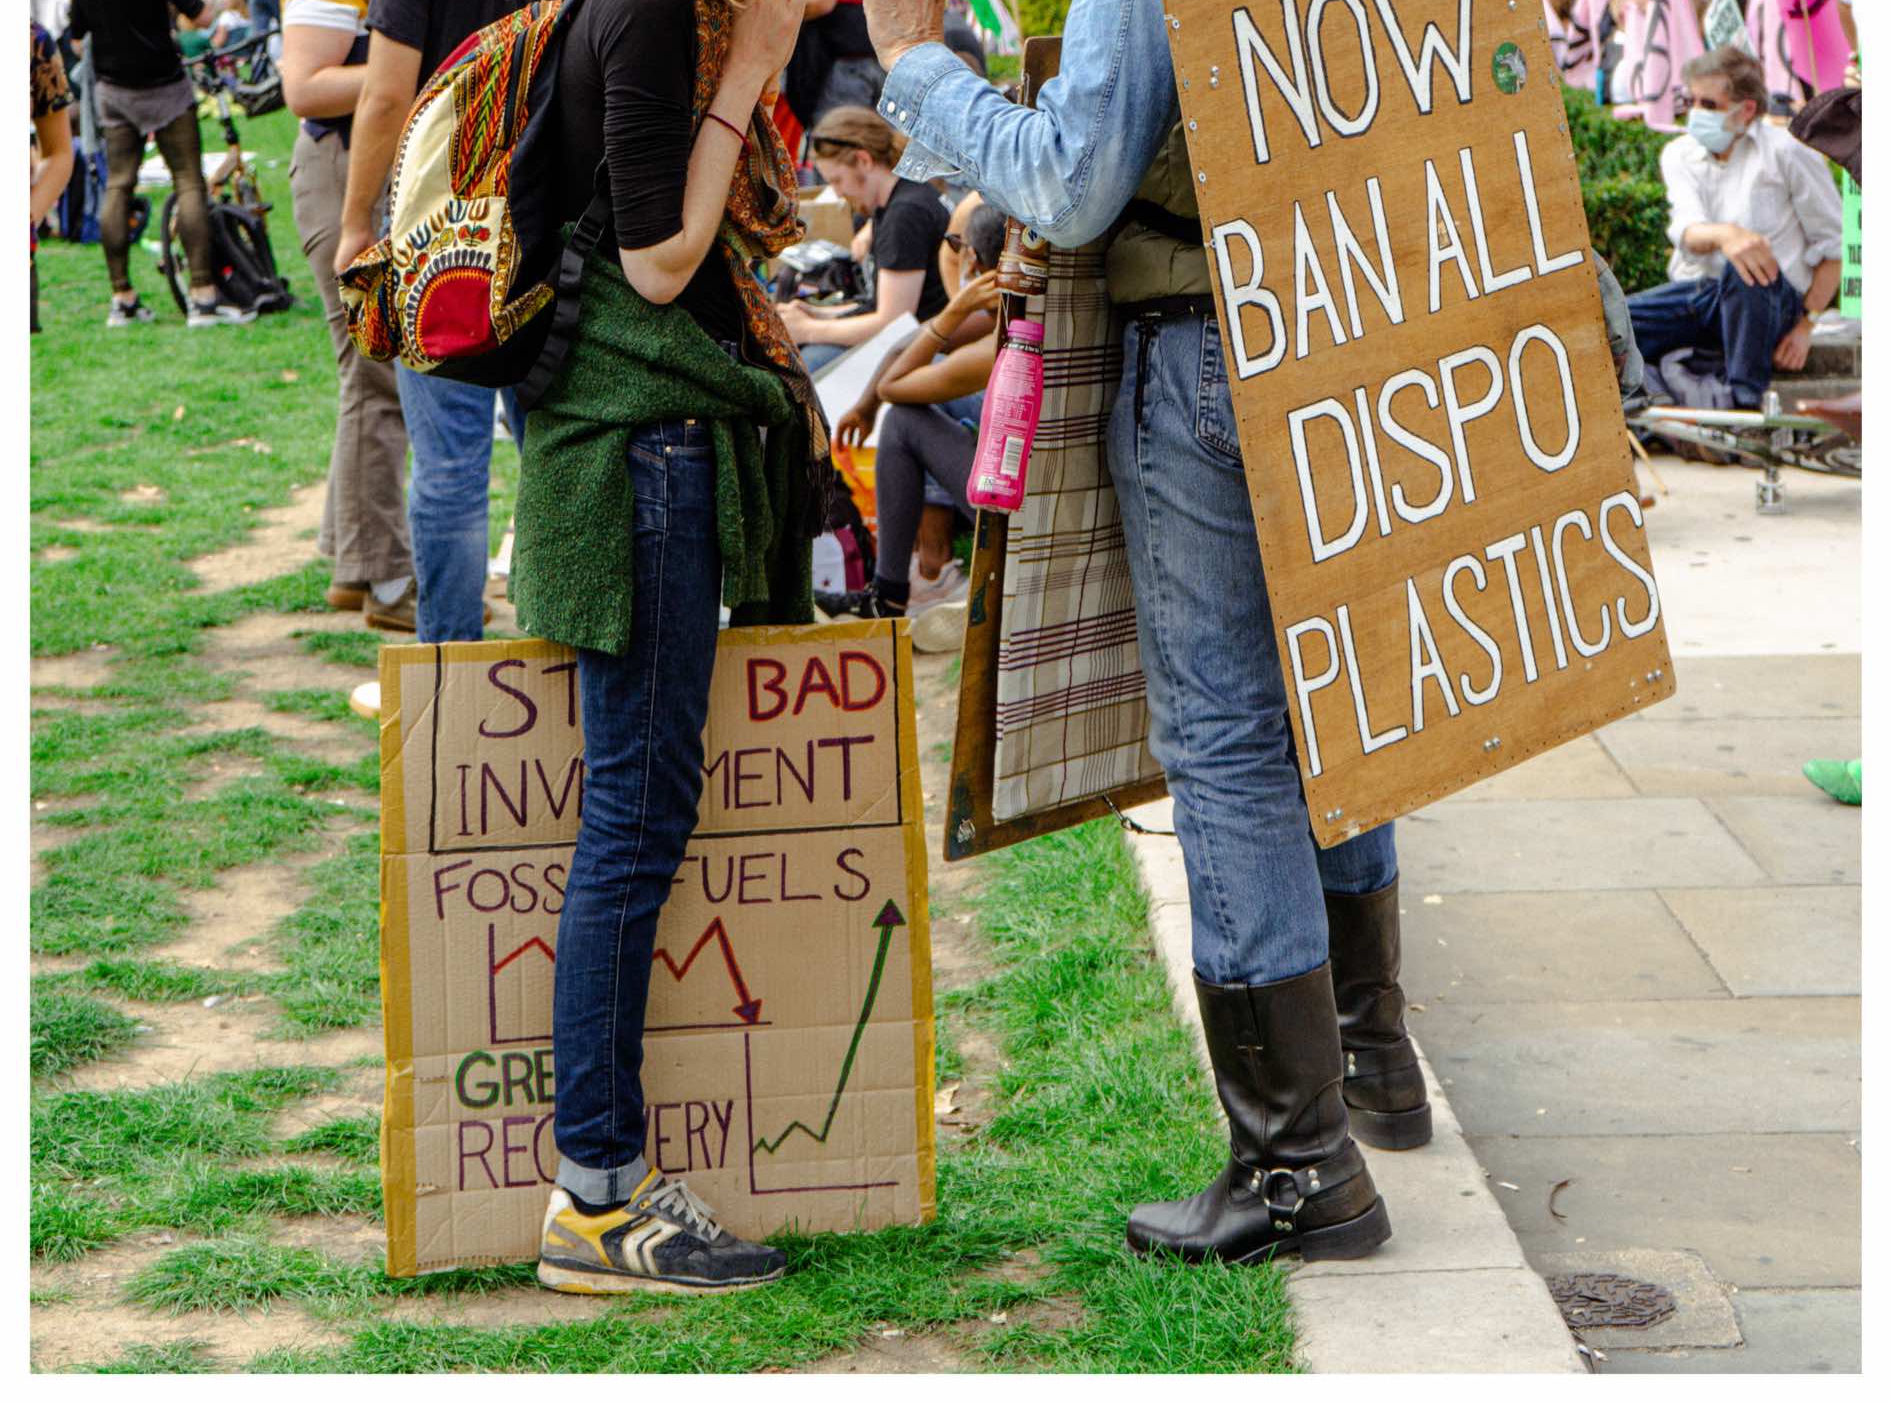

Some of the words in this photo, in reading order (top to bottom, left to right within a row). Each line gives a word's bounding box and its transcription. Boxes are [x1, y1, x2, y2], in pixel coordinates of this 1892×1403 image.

[1211, 176, 1406, 380] BAN
[1424, 130, 1584, 314] ALL
[1287, 324, 1582, 563] DISPO
[1285, 491, 1661, 778] PLASTICS
[478, 659, 579, 739] ST
[746, 651, 887, 723] BAD
[456, 735, 875, 836] INVMENT
[433, 859, 567, 920] FOSS
[455, 1049, 555, 1109] GRE
[457, 1099, 734, 1192] RECERY
